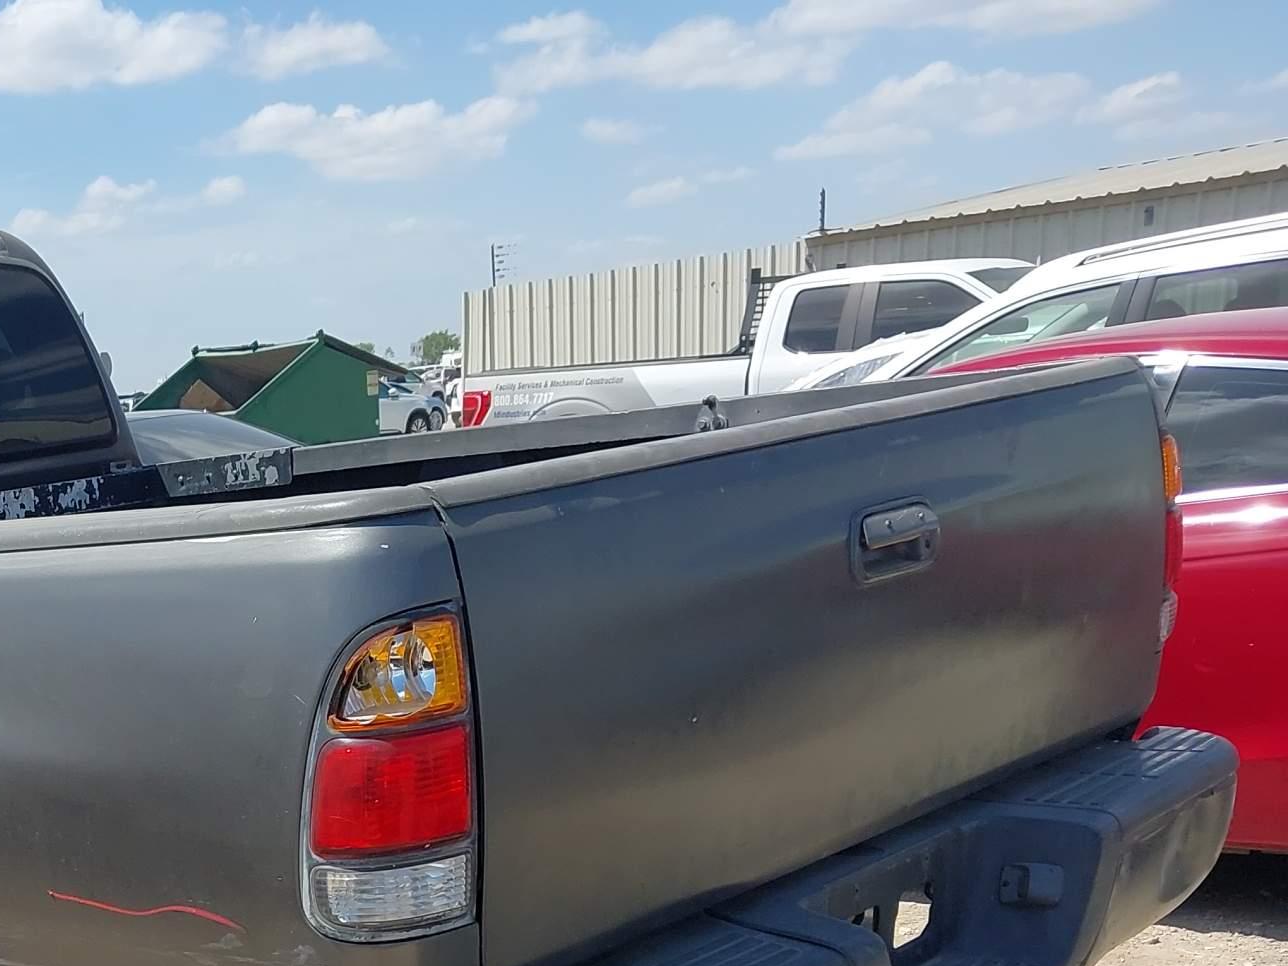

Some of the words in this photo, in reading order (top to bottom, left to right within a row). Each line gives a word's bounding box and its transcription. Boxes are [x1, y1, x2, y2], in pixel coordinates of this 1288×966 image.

[495, 383, 516, 392] Facility
[517, 381, 542, 391] Services
[543, 380, 548, 388] &
[550, 378, 585, 388] Mechanical
[585, 376, 624, 386] Construction
